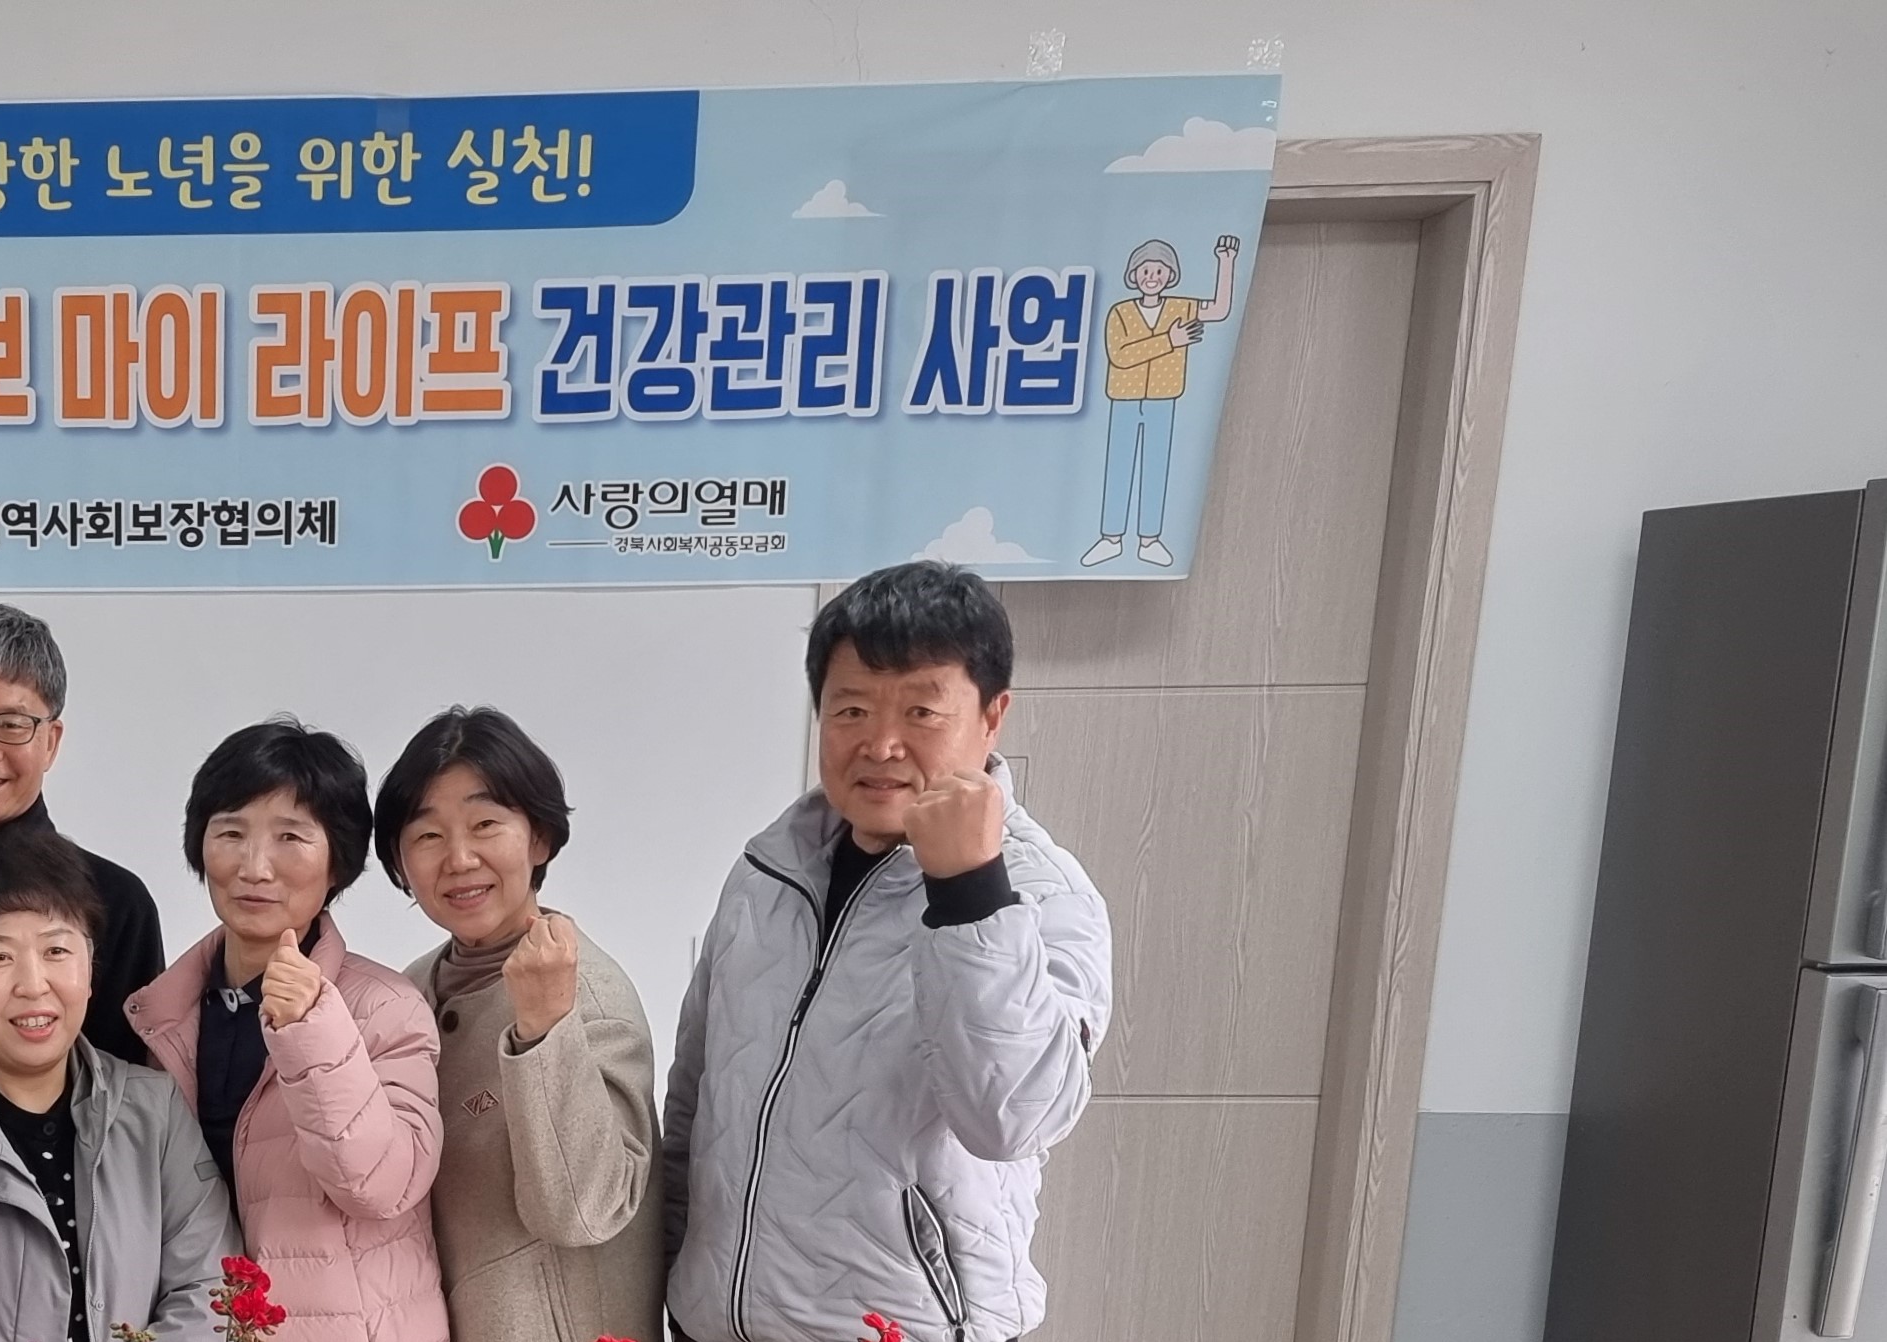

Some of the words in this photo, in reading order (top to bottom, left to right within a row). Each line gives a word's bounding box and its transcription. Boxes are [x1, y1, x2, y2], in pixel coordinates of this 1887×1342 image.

[106, 131, 271, 209] 노년을
[296, 129, 422, 205] 위한
[446, 128, 594, 204] 실천!
[61, 289, 218, 422] 마이
[253, 287, 505, 419] 라이프
[537, 279, 883, 415] 건강관리
[912, 273, 1086, 408] 사업
[550, 480, 787, 529] 사랑의열매
[615, 534, 786, 557] 경북사회복지공동모금회
